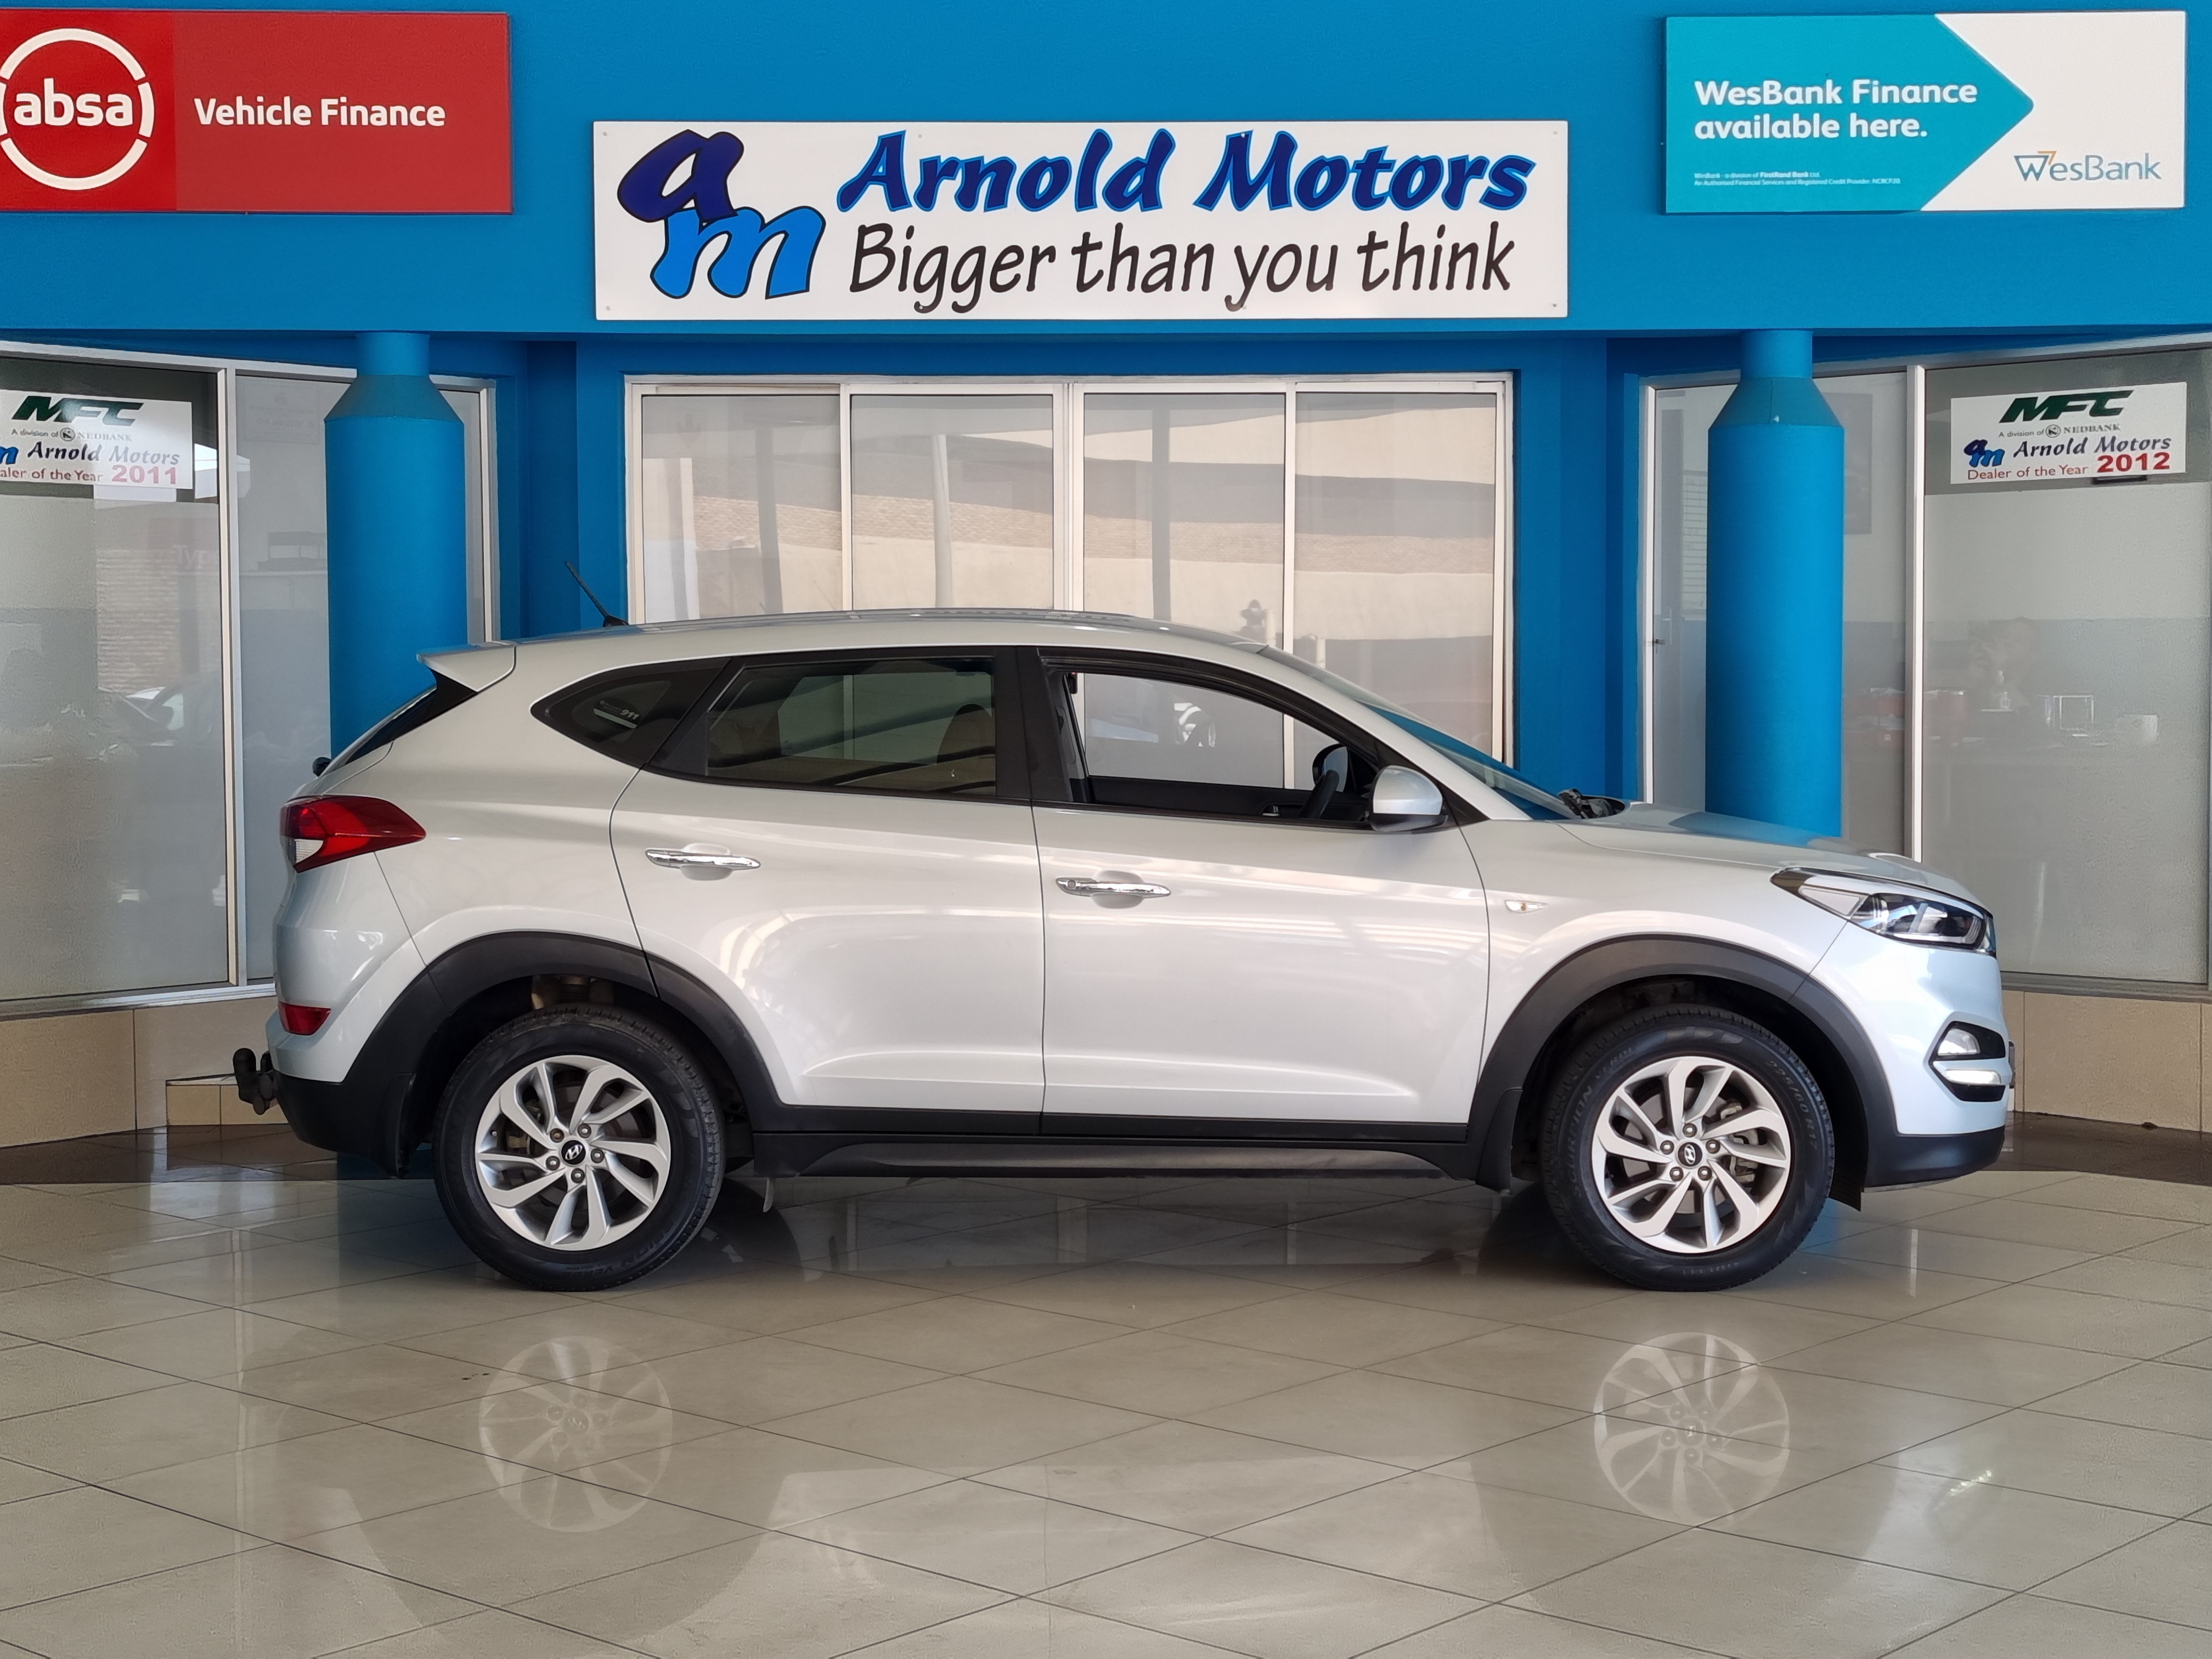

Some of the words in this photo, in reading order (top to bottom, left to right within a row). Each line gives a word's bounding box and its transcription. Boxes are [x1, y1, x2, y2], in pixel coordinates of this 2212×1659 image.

[14, 77, 134, 126] absa
[1694, 80, 1842, 106] WesBank
[1852, 79, 1978, 104] Finance
[194, 96, 311, 126] Vehicle
[321, 98, 445, 127] Finance
[1694, 114, 1840, 139] available
[1849, 113, 1928, 138] here.
[836, 128, 1176, 213] Arnold
[1193, 129, 1537, 212] Motors
[2013, 150, 2162, 182] WesBank
[850, 223, 1056, 314] Bigger
[1071, 222, 1215, 292] than
[1224, 243, 1339, 312] you
[1357, 221, 1515, 292] think
[12, 396, 144, 426] MFC
[1999, 390, 2134, 424] MFC
[77, 432, 133, 442] NEDBANK
[2007, 430, 2035, 438] division
[2063, 423, 2121, 435] NEDBANK
[27, 441, 103, 461] Arnold
[109, 445, 180, 466] Motors
[2013, 437, 2088, 458] Arnold
[2094, 436, 2172, 453] Motors
[32, 468, 46, 479] of
[50, 469, 72, 481] the
[74, 470, 104, 482] Year
[111, 464, 177, 485] 2011
[1967, 469, 2012, 481] Dealer
[2017, 467, 2031, 478] of
[2034, 467, 2056, 477] the
[2058, 465, 2089, 475] Year
[2097, 452, 2171, 473] 2012
[619, 709, 640, 720] 911
